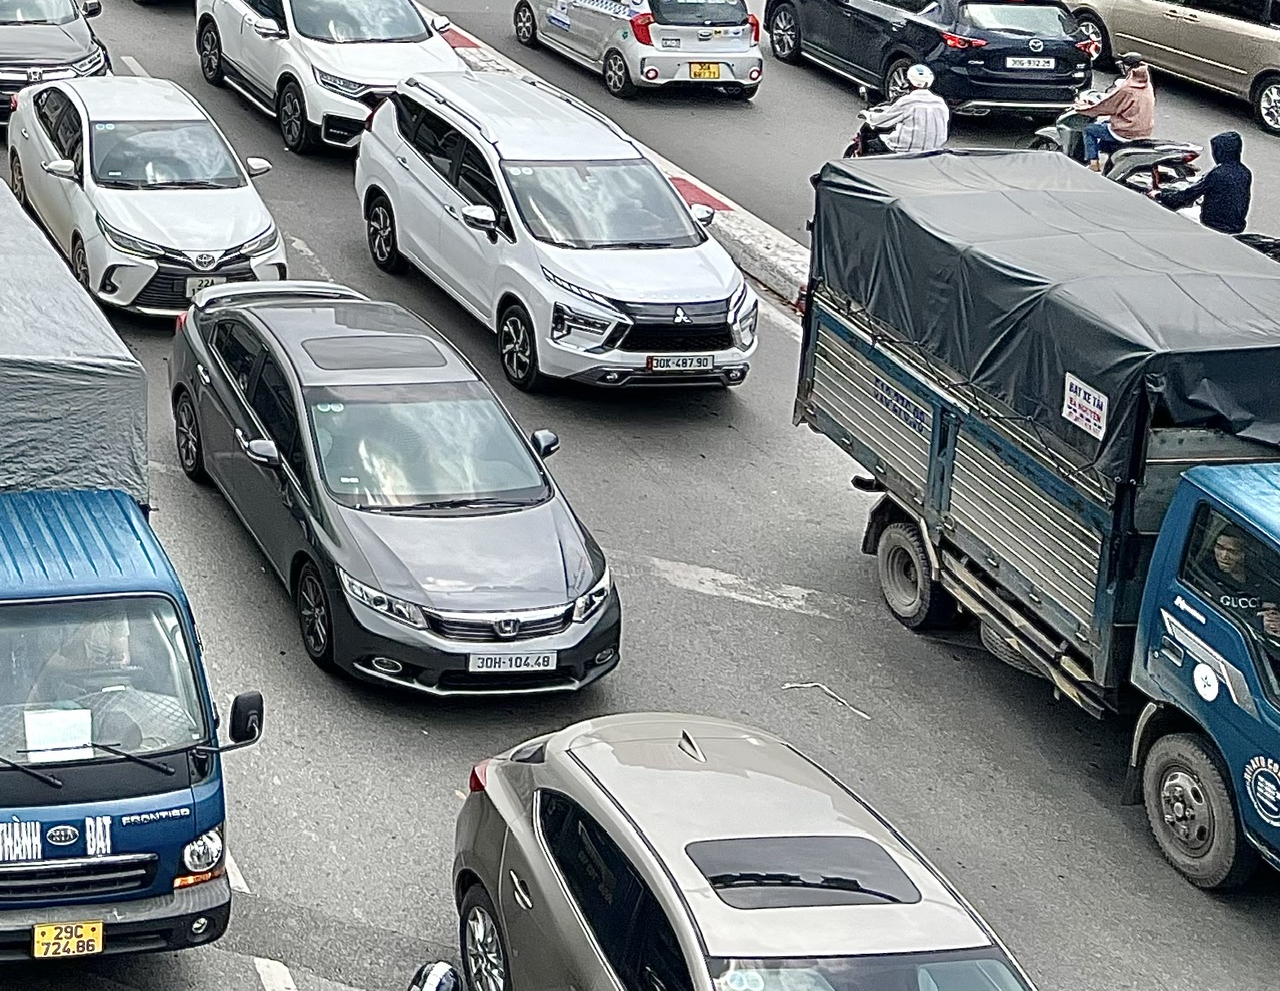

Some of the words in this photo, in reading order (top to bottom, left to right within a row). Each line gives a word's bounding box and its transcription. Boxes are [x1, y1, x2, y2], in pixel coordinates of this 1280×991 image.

[476, 655, 551, 669] 30H-104.48
[53, 925, 84, 941] 29C
[41, 940, 96, 957] 724.86
